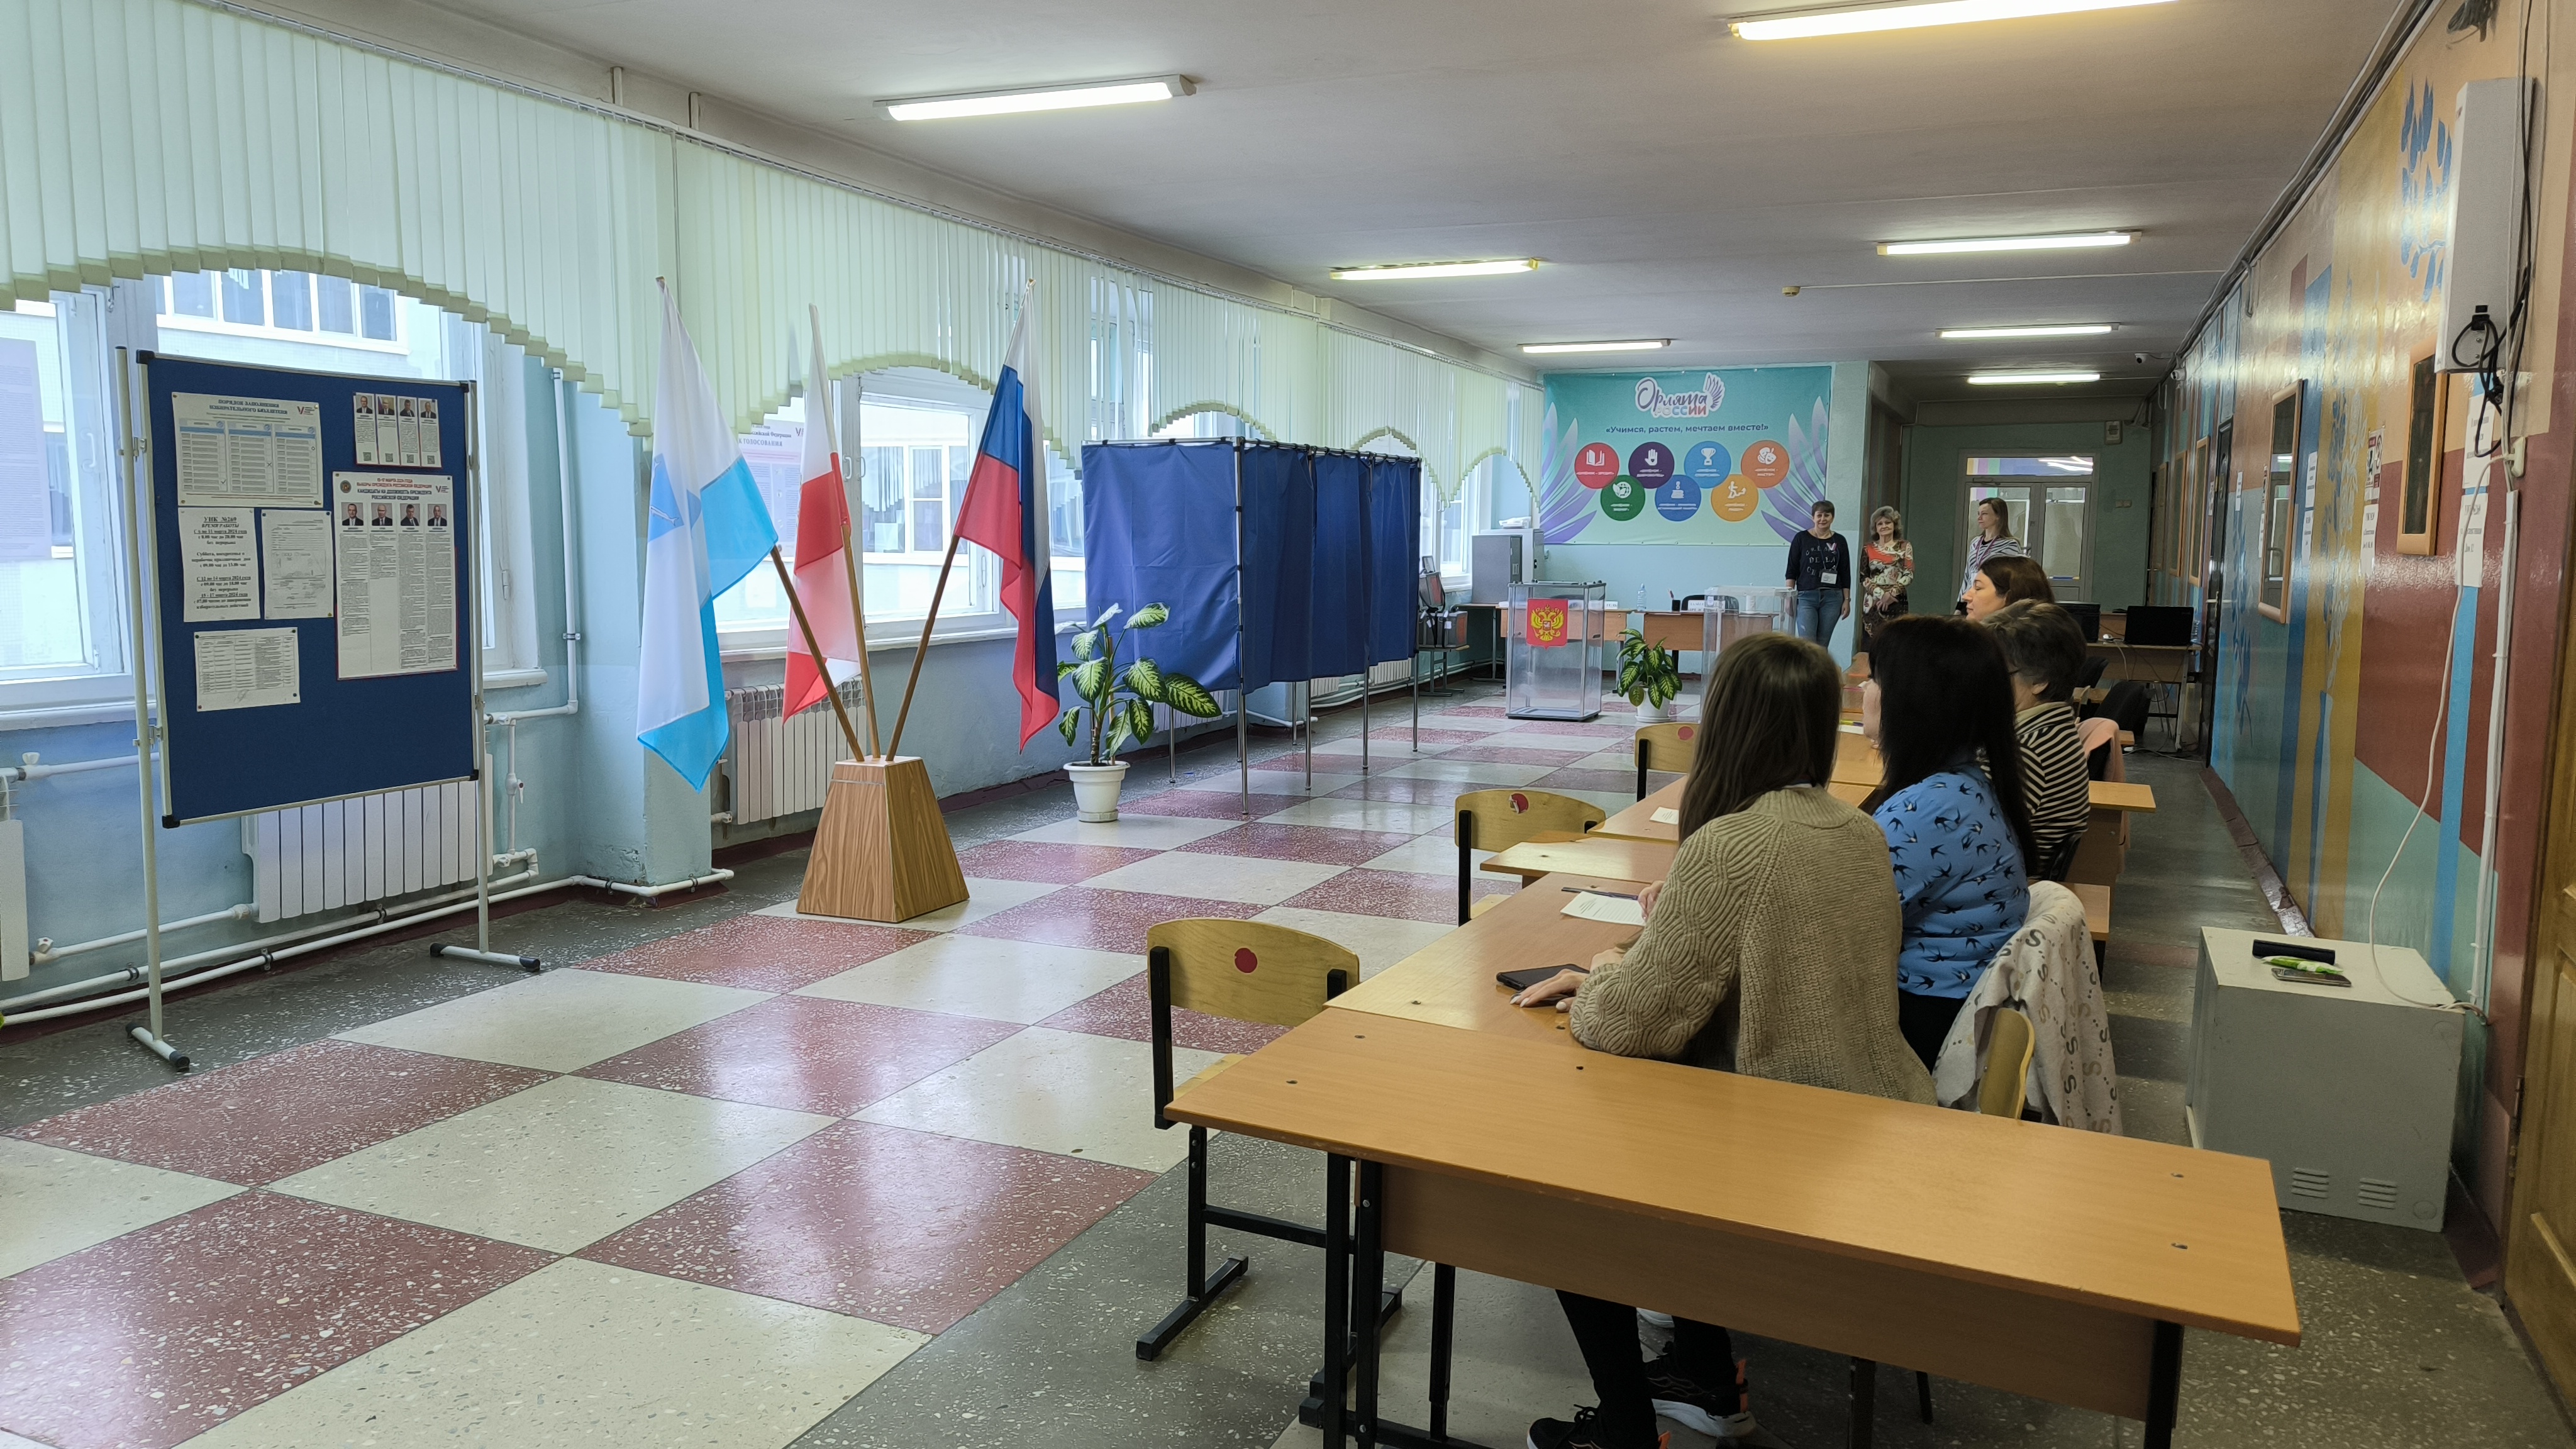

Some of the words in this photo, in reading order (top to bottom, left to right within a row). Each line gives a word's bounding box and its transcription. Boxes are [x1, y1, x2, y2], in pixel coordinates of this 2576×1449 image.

[1637, 379, 1707, 412] Орлята
[1654, 405, 1706, 416] РОССИИ
[743, 438, 782, 447] ГОЛОСОВАНИЯ
